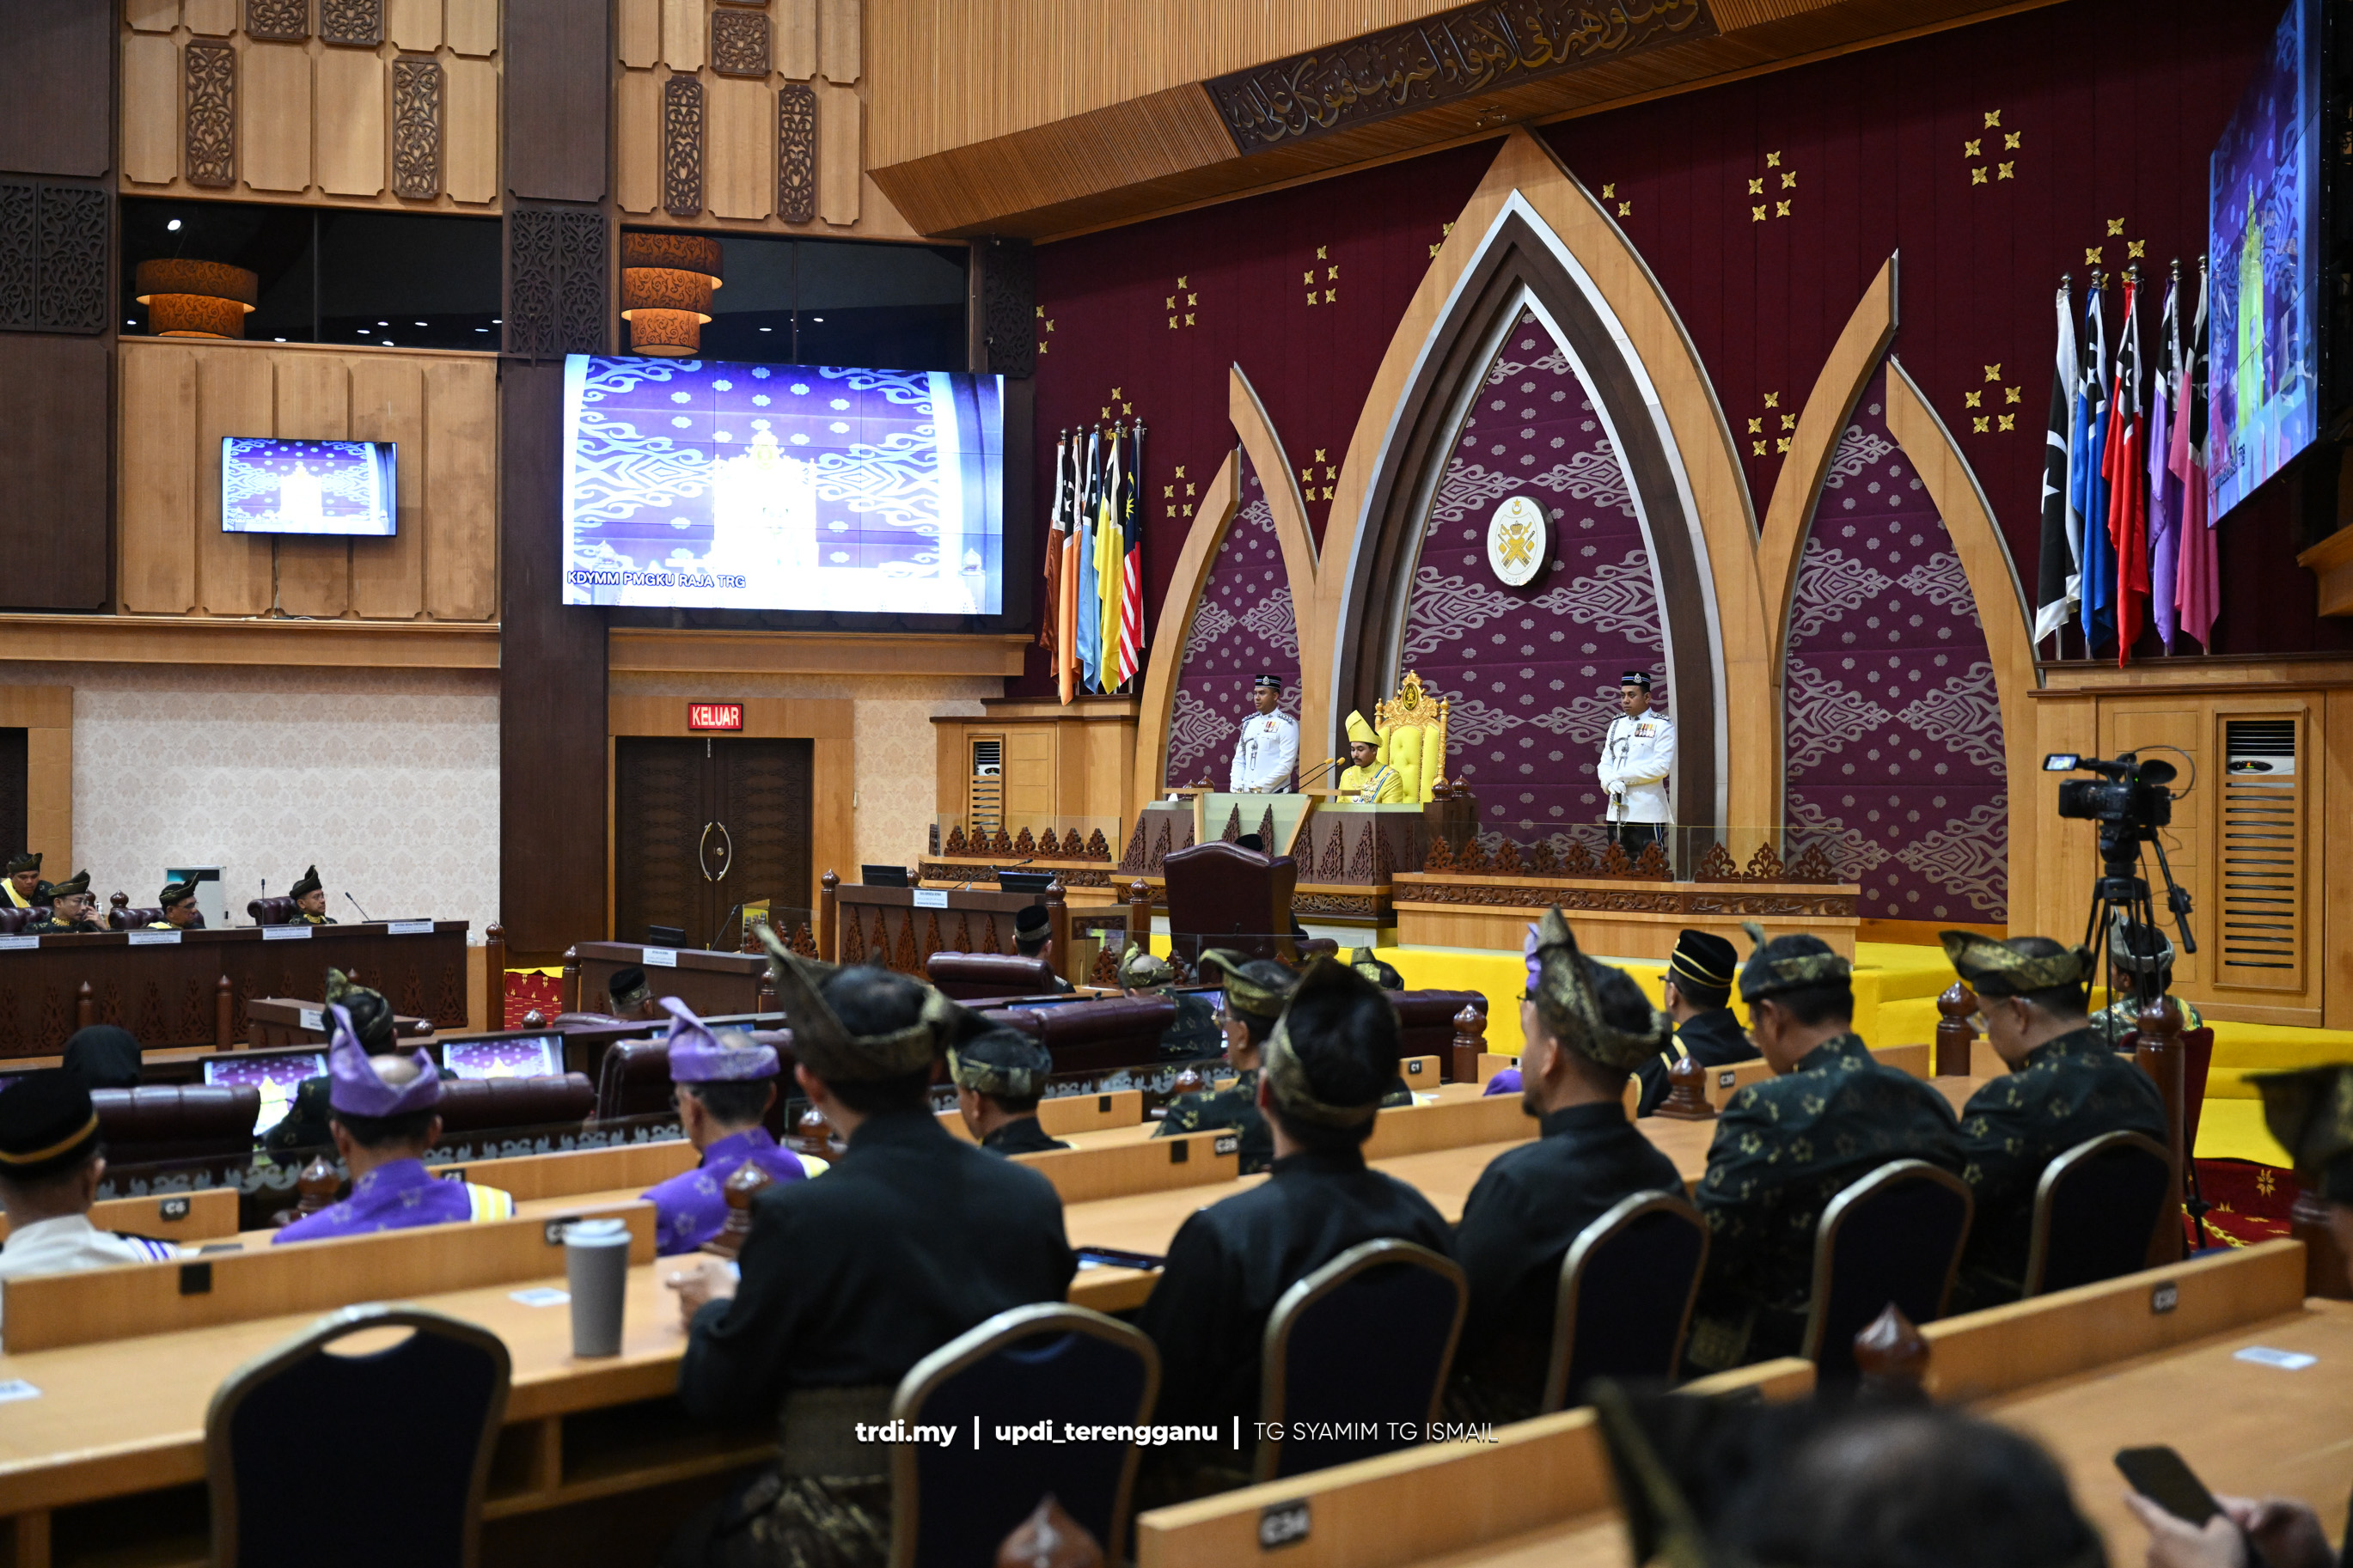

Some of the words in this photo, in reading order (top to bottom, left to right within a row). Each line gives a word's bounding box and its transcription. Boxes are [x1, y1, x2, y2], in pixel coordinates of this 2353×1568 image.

[567, 570, 620, 585] KDYMM
[623, 571, 675, 587] PMGKU
[678, 574, 714, 588] RAJA
[717, 575, 746, 588] TRG
[693, 706, 739, 726] KELUAR
[1410, 1063, 1420, 1072] C1
